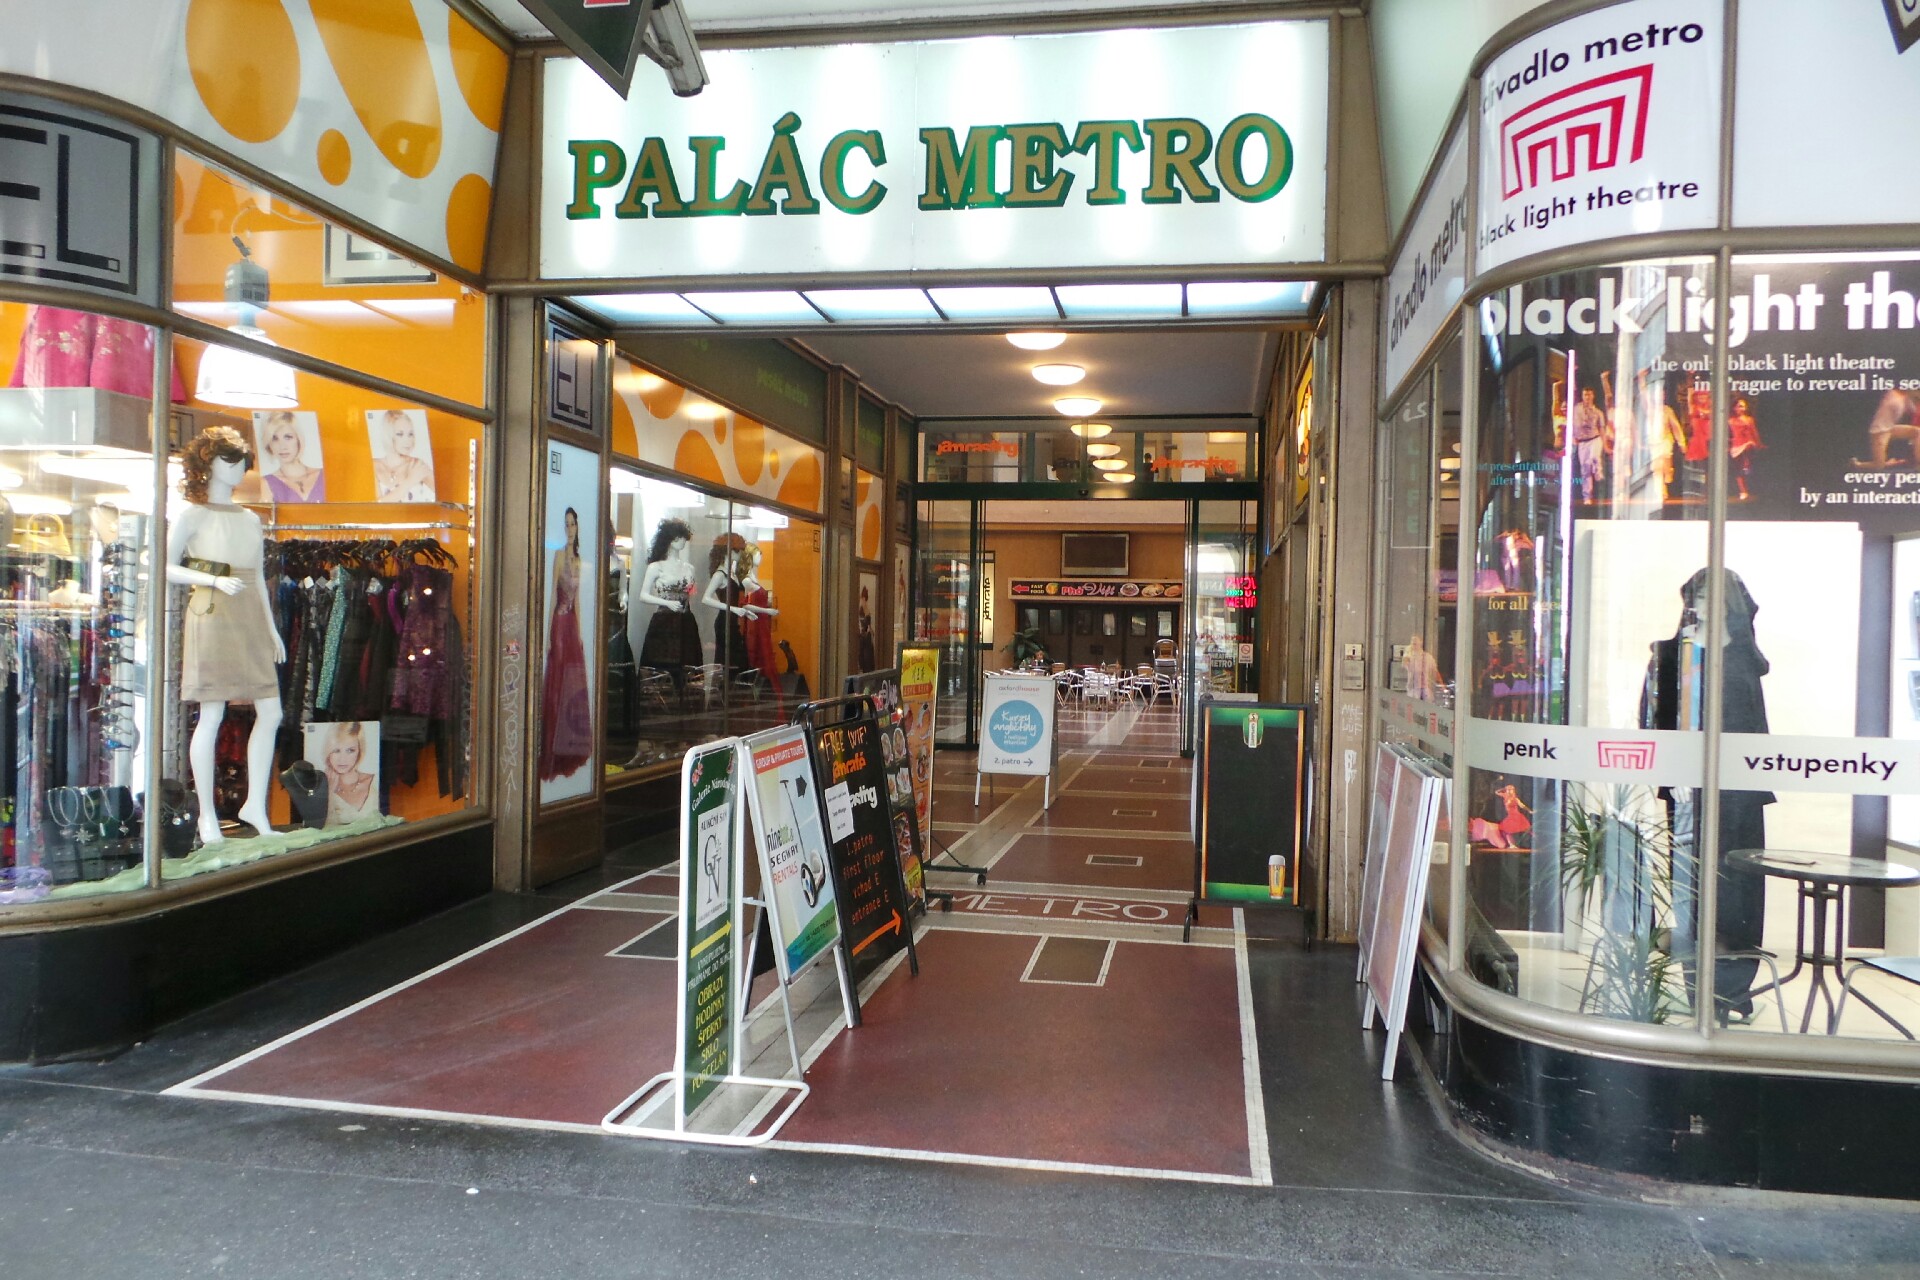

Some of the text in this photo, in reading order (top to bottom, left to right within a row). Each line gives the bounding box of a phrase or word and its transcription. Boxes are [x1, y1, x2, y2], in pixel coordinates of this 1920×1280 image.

[1482, 22, 1704, 115] divadlo metro
[566, 111, 1294, 220] PALÁC METRO
[1480, 180, 1700, 251] black light theatre
[1390, 252, 1427, 352] divadlo
[1480, 277, 1643, 336] black
[1666, 274, 1824, 348] light
[1650, 353, 1895, 374] the onl black light theatre
[1694, 375, 1711, 391] in
[1786, 377, 1805, 391] to
[1808, 374, 1867, 391] reveal
[1871, 374, 1896, 390] its
[1899, 379, 1920, 391] se
[1552, 476, 1584, 487] sow
[1843, 472, 1891, 488] every
[1800, 487, 1822, 507] by
[1826, 492, 1848, 504] an
[1488, 596, 1506, 610] for
[1509, 596, 1528, 610] all
[1503, 738, 1558, 761] penk
[1743, 752, 1898, 781] vstupenky
[691, 784, 711, 812] Galerie
[849, 784, 878, 809] asting
[770, 842, 799, 868] SEGWAY
[864, 849, 885, 869] floor
[773, 860, 799, 884] RENTALS
[874, 872, 880, 886] E
[883, 889, 890, 903] E
[926, 894, 1169, 921] METRO
[697, 974, 724, 1007] OBRAZY
[695, 991, 726, 1030] HODINKY
[697, 1014, 723, 1048] ŠPERKY
[700, 1037, 719, 1064] SKLO
[691, 1049, 727, 1093] PORCELÁN
